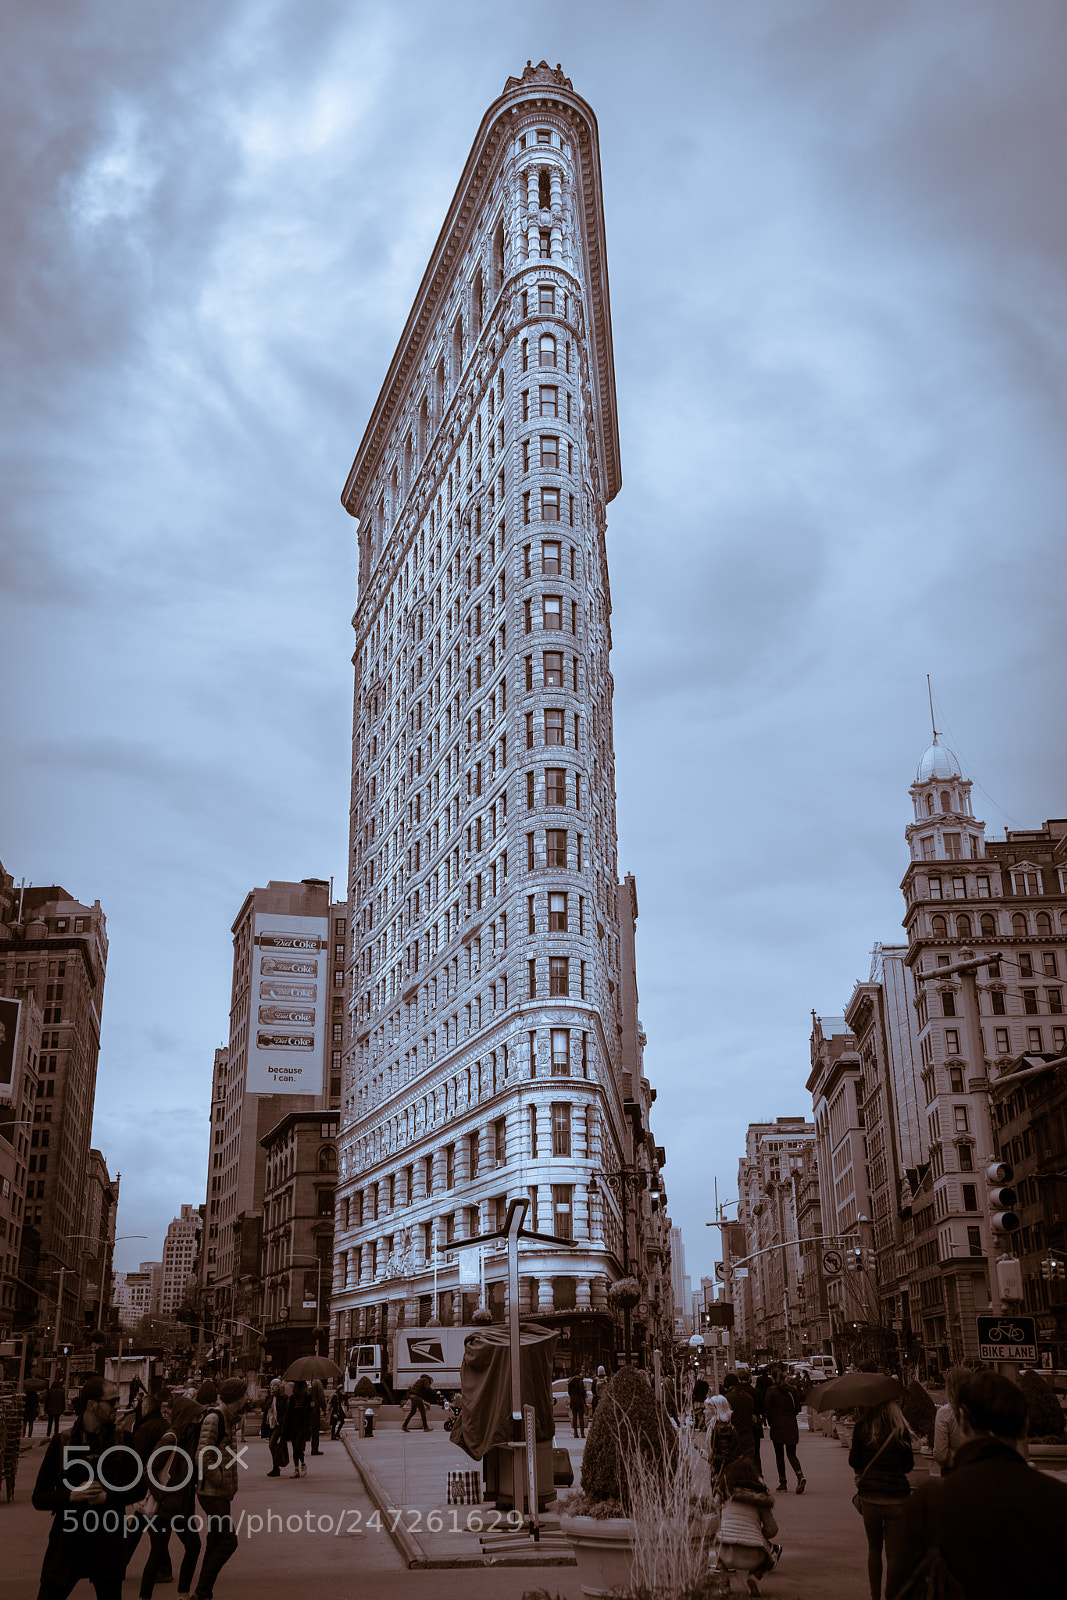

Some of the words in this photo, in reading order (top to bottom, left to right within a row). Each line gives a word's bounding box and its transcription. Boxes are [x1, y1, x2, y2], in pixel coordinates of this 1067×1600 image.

[274, 938, 292, 947] Diet
[293, 939, 317, 949] Coke
[277, 963, 291, 971] Diet
[291, 964, 314, 973] Coke
[290, 989, 313, 998] Coke
[289, 1013, 312, 1022] Coke
[288, 1037, 311, 1046] Coke
[268, 1066, 303, 1074] because
[274, 1074, 276, 1082] I
[982, 1346, 1004, 1357] BIKE
[1009, 1347, 1034, 1358] LANE
